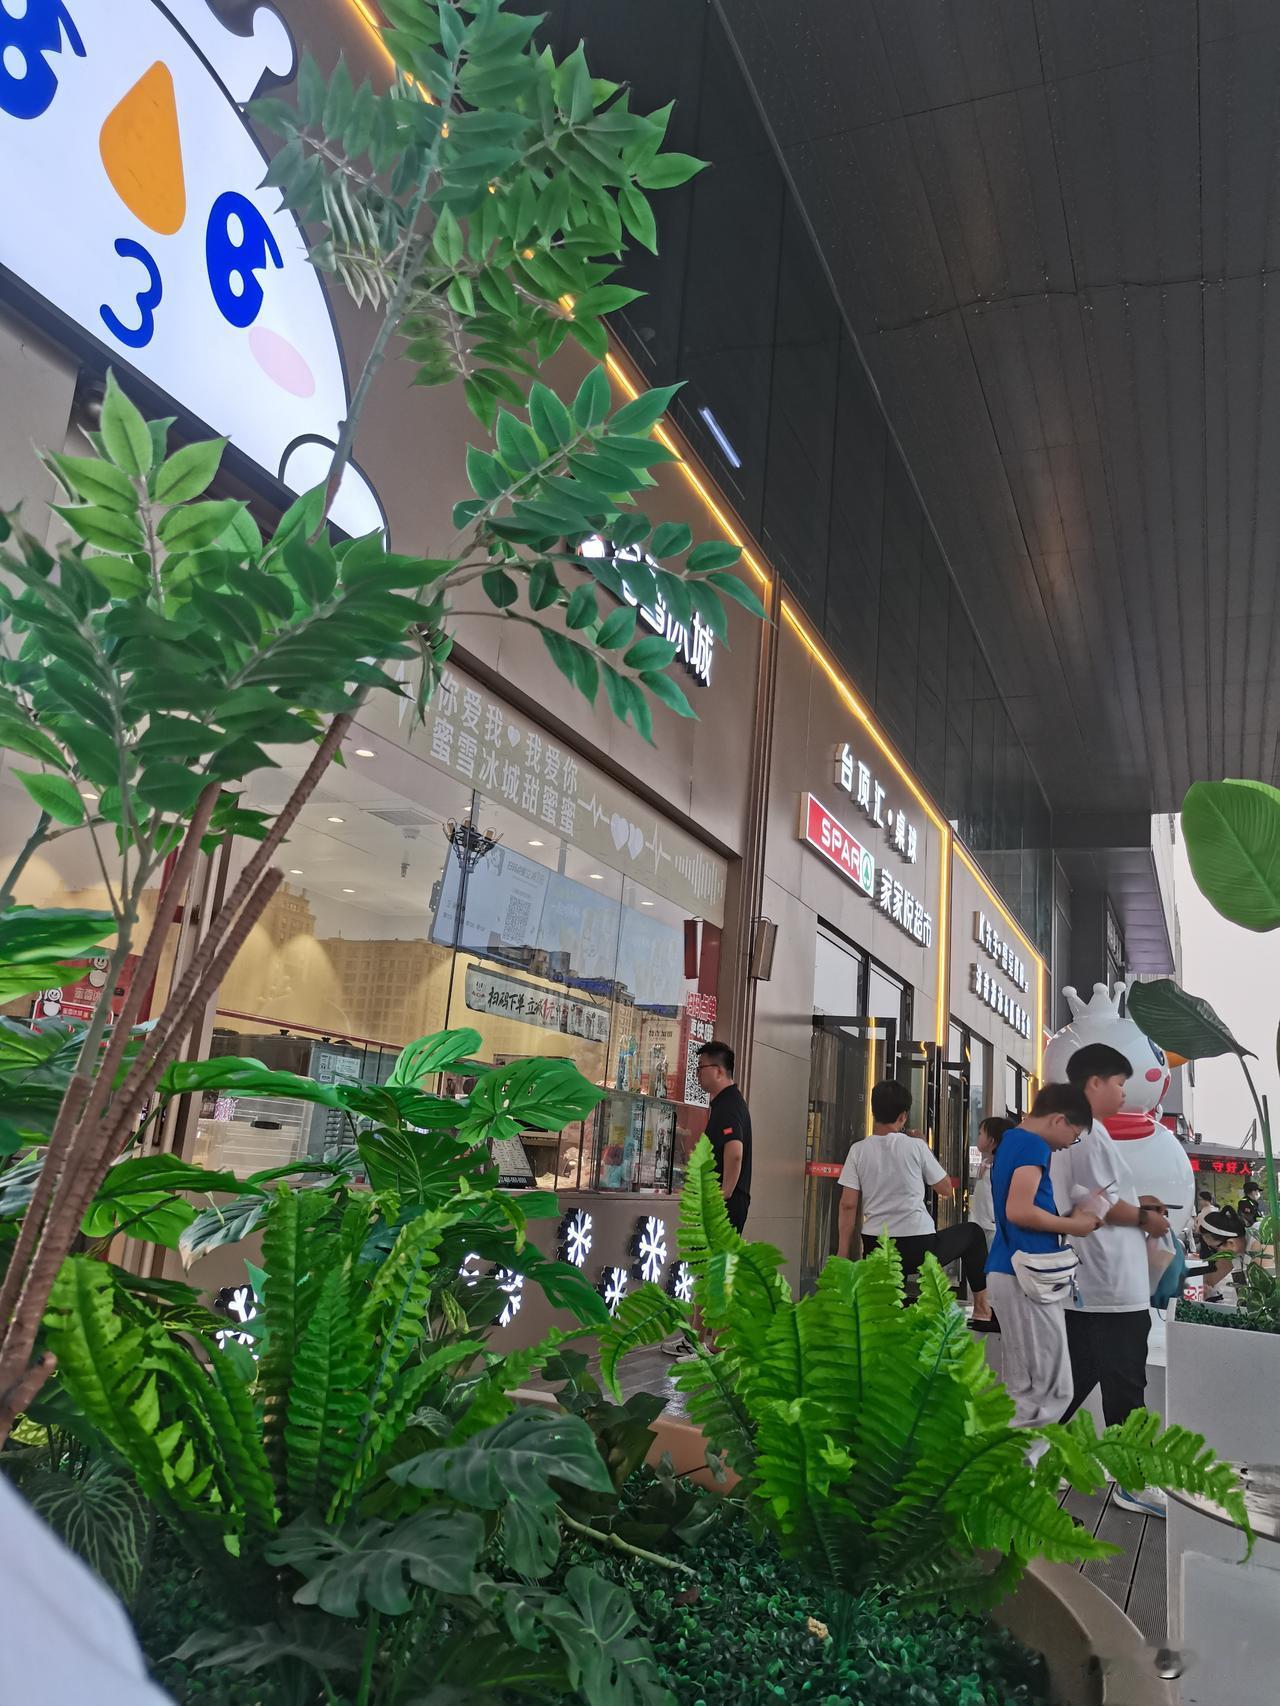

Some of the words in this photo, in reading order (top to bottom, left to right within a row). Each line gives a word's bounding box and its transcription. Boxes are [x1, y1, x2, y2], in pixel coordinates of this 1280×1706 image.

[430, 716, 577, 837] 蜜雪冰城甜蜜蜜
[438, 670, 504, 749] 你爱我
[525, 732, 578, 795] 我爱你
[820, 816, 861, 876] SPAR
[879, 867, 933, 949] 家家悦超市
